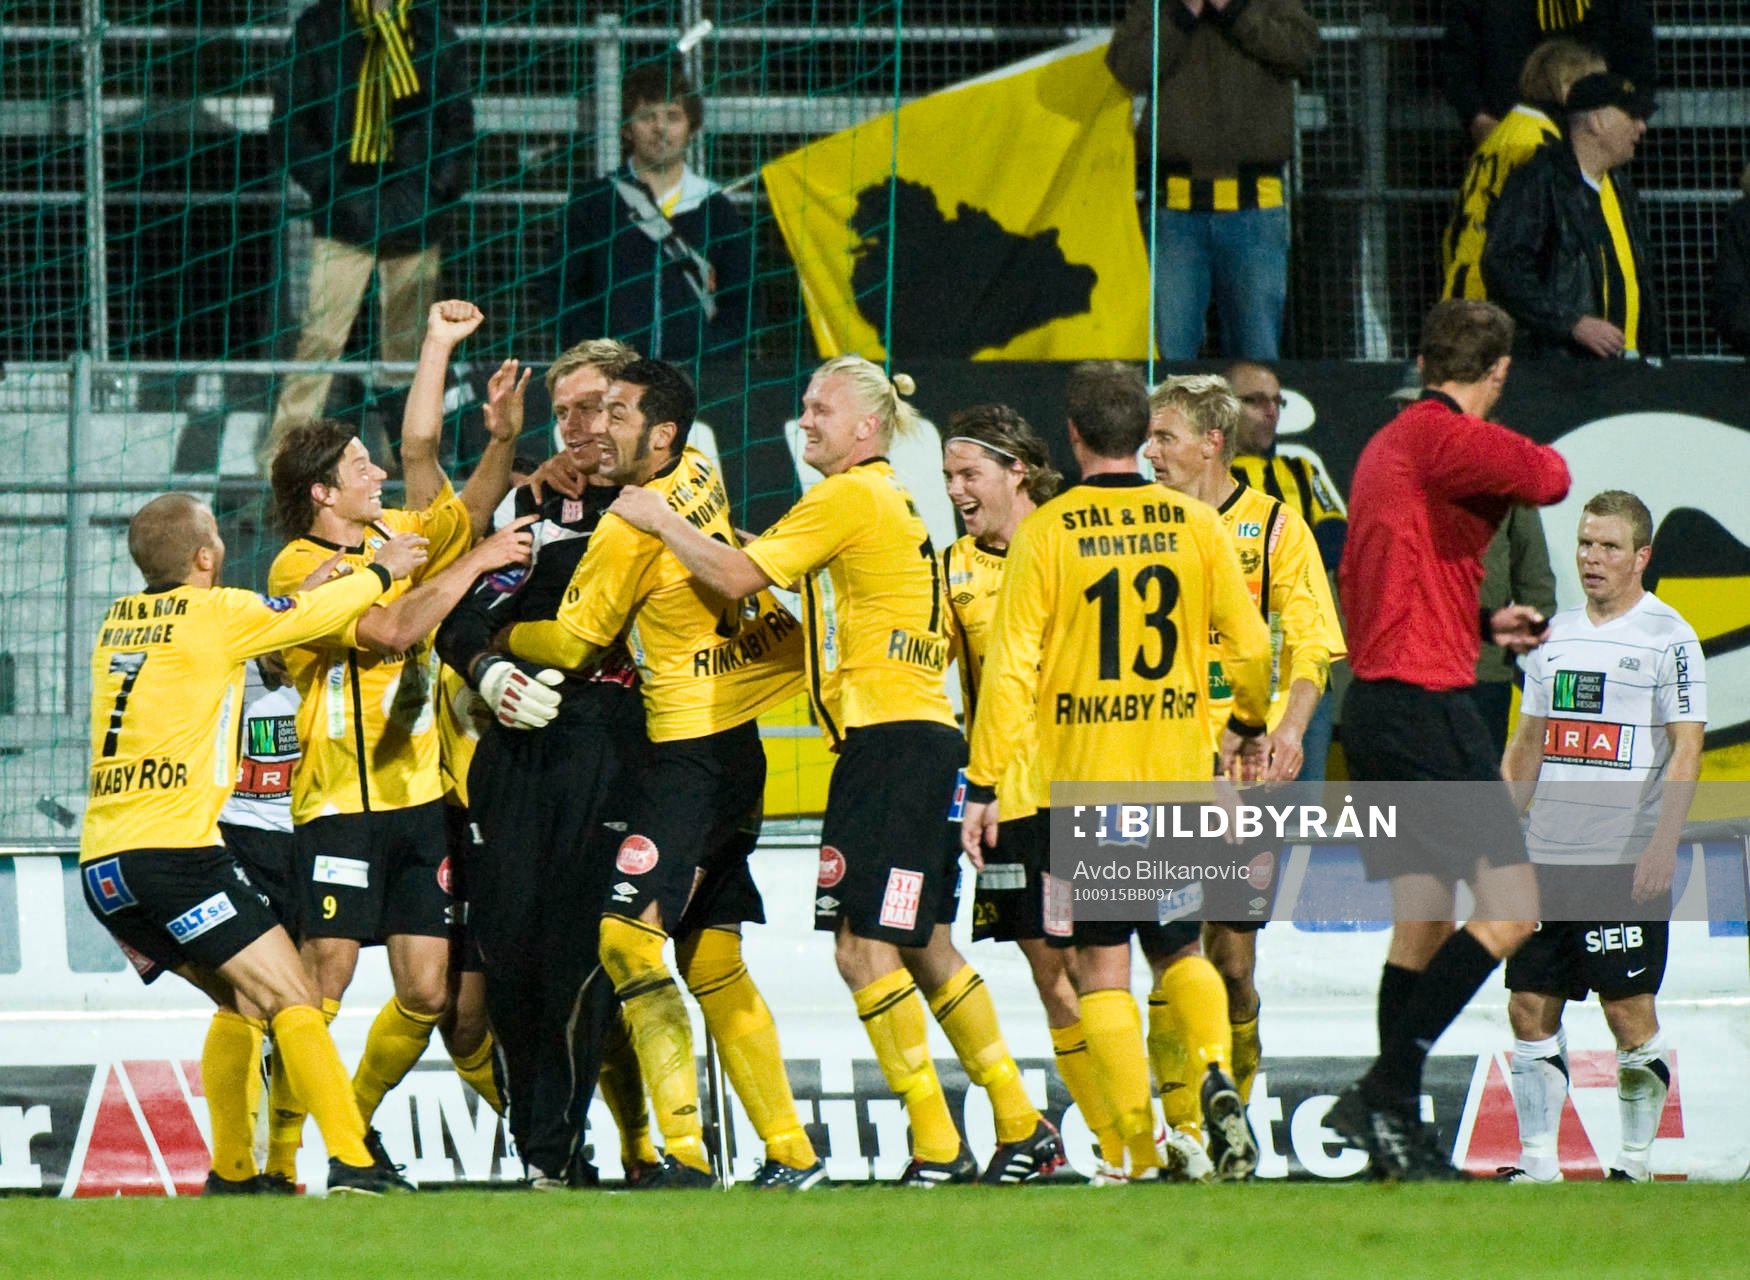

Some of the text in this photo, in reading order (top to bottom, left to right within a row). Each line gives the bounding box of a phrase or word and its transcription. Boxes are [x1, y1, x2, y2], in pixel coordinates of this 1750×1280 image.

[1062, 502, 1186, 530] STÅL & RÖR
[1078, 531, 1179, 557] MONTAGE
[137, 602, 148, 619] &
[153, 596, 189, 618] RÖR
[1084, 564, 1180, 680] 13
[100, 623, 174, 648] MONTAGE
[693, 626, 773, 677] RINKABY
[1576, 691, 1594, 700] PARK
[1675, 645, 1691, 715] stadium
[102, 651, 148, 757] 7
[1056, 686, 1197, 725] RINKABY RÖR
[1576, 699, 1602, 709] RESORT
[139, 756, 188, 790] RÖR
[169, 898, 230, 937] BLT.se
[322, 895, 338, 920] 9
